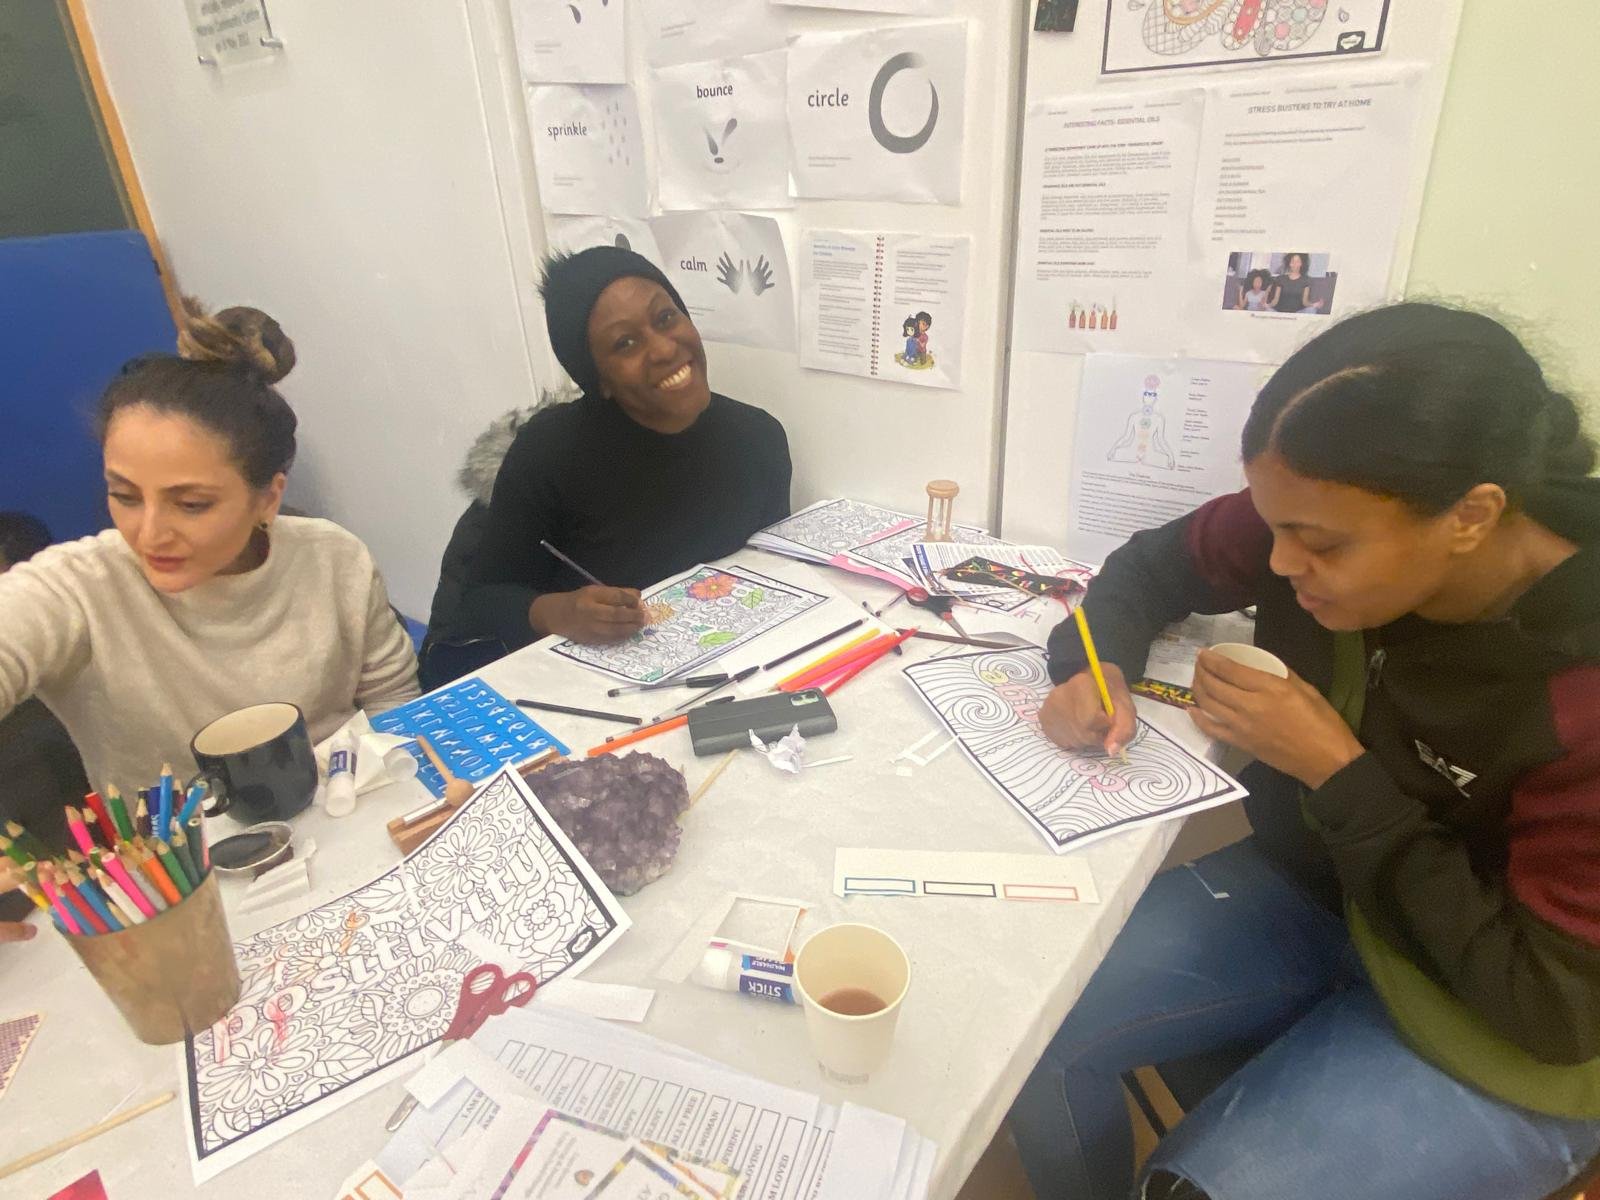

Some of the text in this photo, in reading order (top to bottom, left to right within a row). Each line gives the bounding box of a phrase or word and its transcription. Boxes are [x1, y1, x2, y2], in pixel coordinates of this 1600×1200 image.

[696, 84, 733, 99] bounce
[808, 87, 849, 107] circle
[1248, 104, 1277, 114] STRESS
[1277, 102, 1311, 113] BUSTERS
[1349, 98, 1373, 107] HOME
[547, 121, 588, 142] sprinkle
[680, 256, 708, 272] calm
[748, 981, 782, 997] STICK
[683, 1096, 699, 1120] FREE
[700, 1110, 720, 1148] WOMAN
[774, 1154, 791, 1189] LOVED
